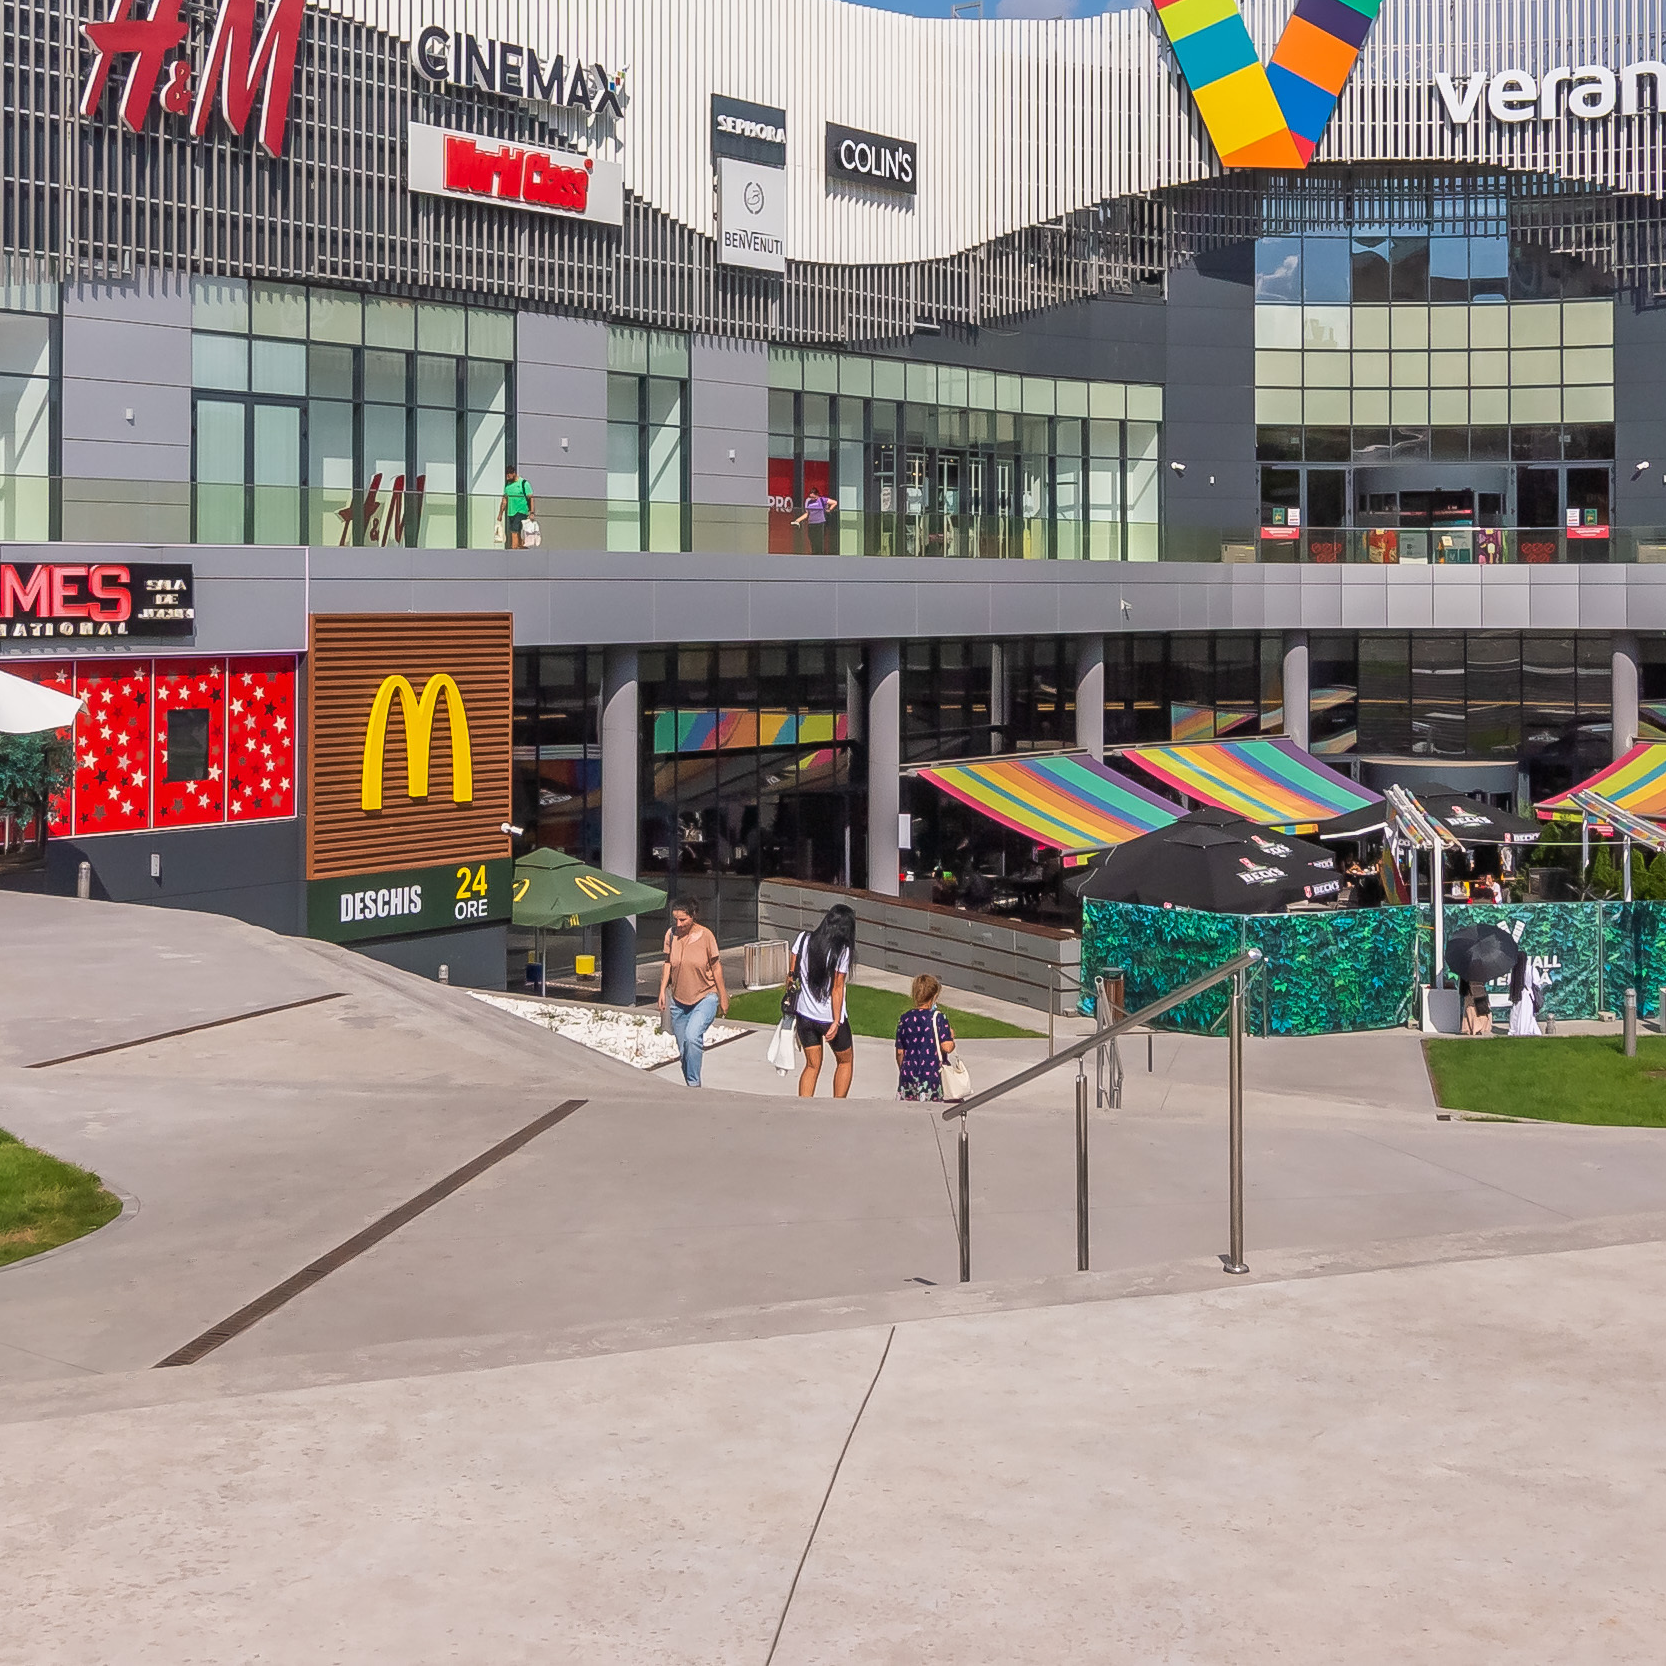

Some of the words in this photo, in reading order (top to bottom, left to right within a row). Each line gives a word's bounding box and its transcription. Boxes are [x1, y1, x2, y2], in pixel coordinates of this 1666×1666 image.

[414, 25, 624, 118] CINEMAX
[717, 114, 787, 144] SEPHORA
[840, 138, 913, 183] COLIN'S
[725, 228, 783, 256] BENVENUTI
[456, 865, 487, 900] 24
[340, 885, 422, 922] DESCHIS
[455, 899, 488, 920] ORE
